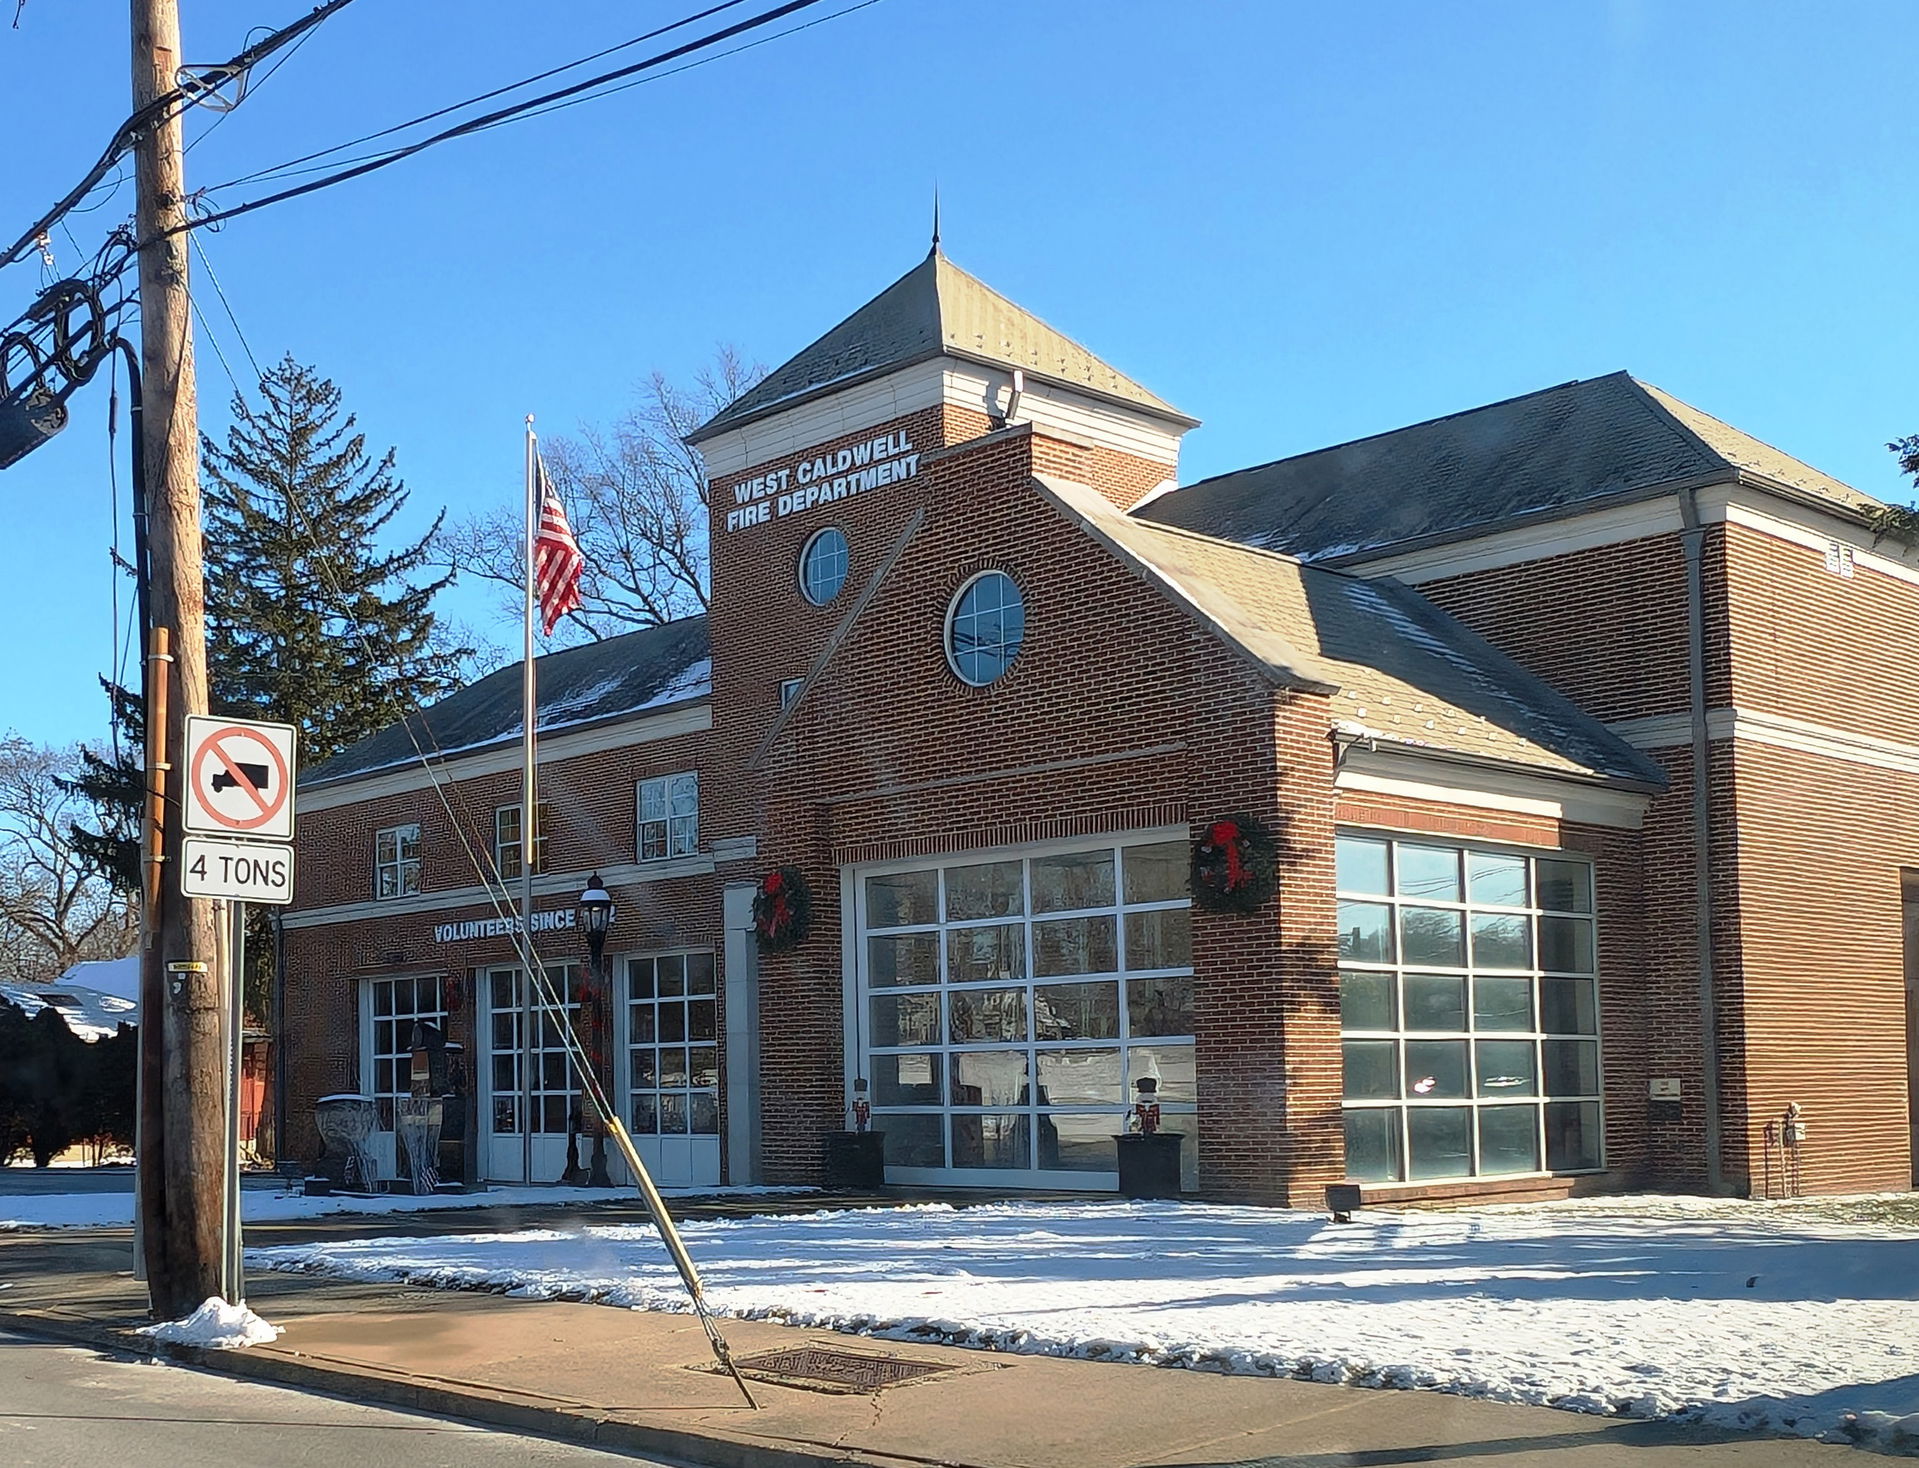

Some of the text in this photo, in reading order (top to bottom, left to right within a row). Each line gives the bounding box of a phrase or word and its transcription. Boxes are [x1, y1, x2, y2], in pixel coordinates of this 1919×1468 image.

[727, 453, 921, 533] FIRE DEPARTMENT
[733, 430, 913, 504] WEST CALDWELL
[189, 854, 287, 888] 4 TONS
[434, 915, 525, 943] VOLUNTEERS
[530, 908, 577, 933] SINCE
